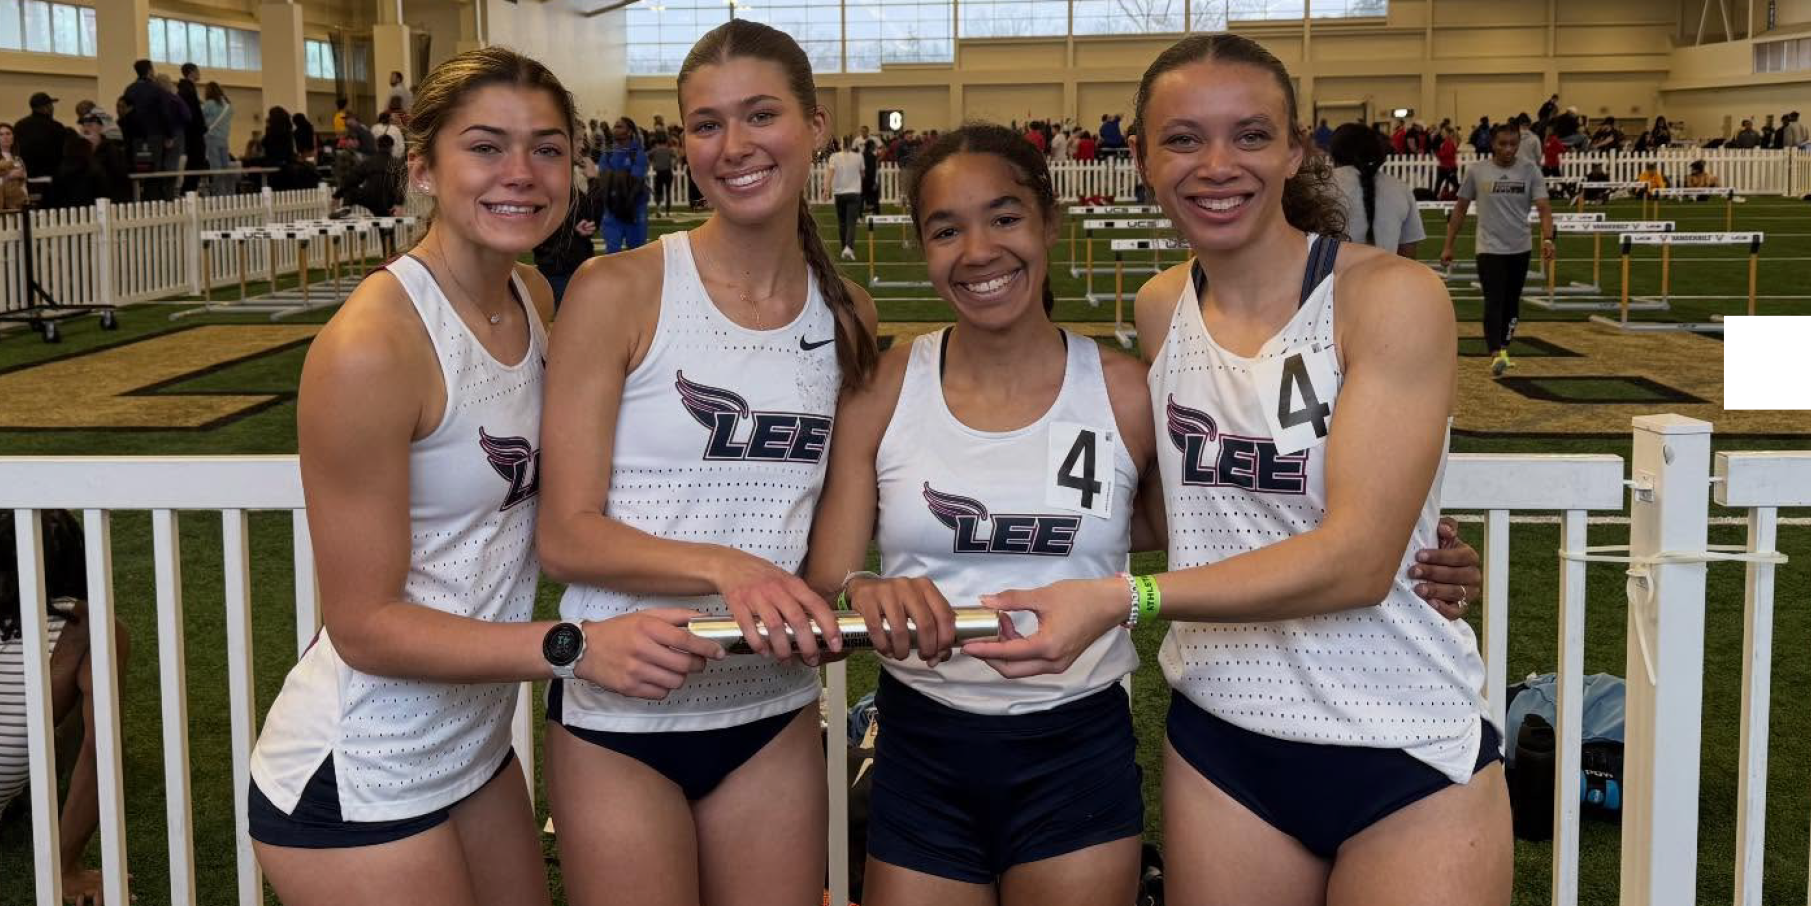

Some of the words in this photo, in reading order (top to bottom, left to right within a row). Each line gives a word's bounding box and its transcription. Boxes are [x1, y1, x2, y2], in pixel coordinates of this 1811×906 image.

[1277, 353, 1331, 439] 4
[703, 410, 834, 464] LEE
[1181, 433, 1311, 495] LEE
[1057, 429, 1102, 509] 4
[953, 513, 1083, 557] LEE
